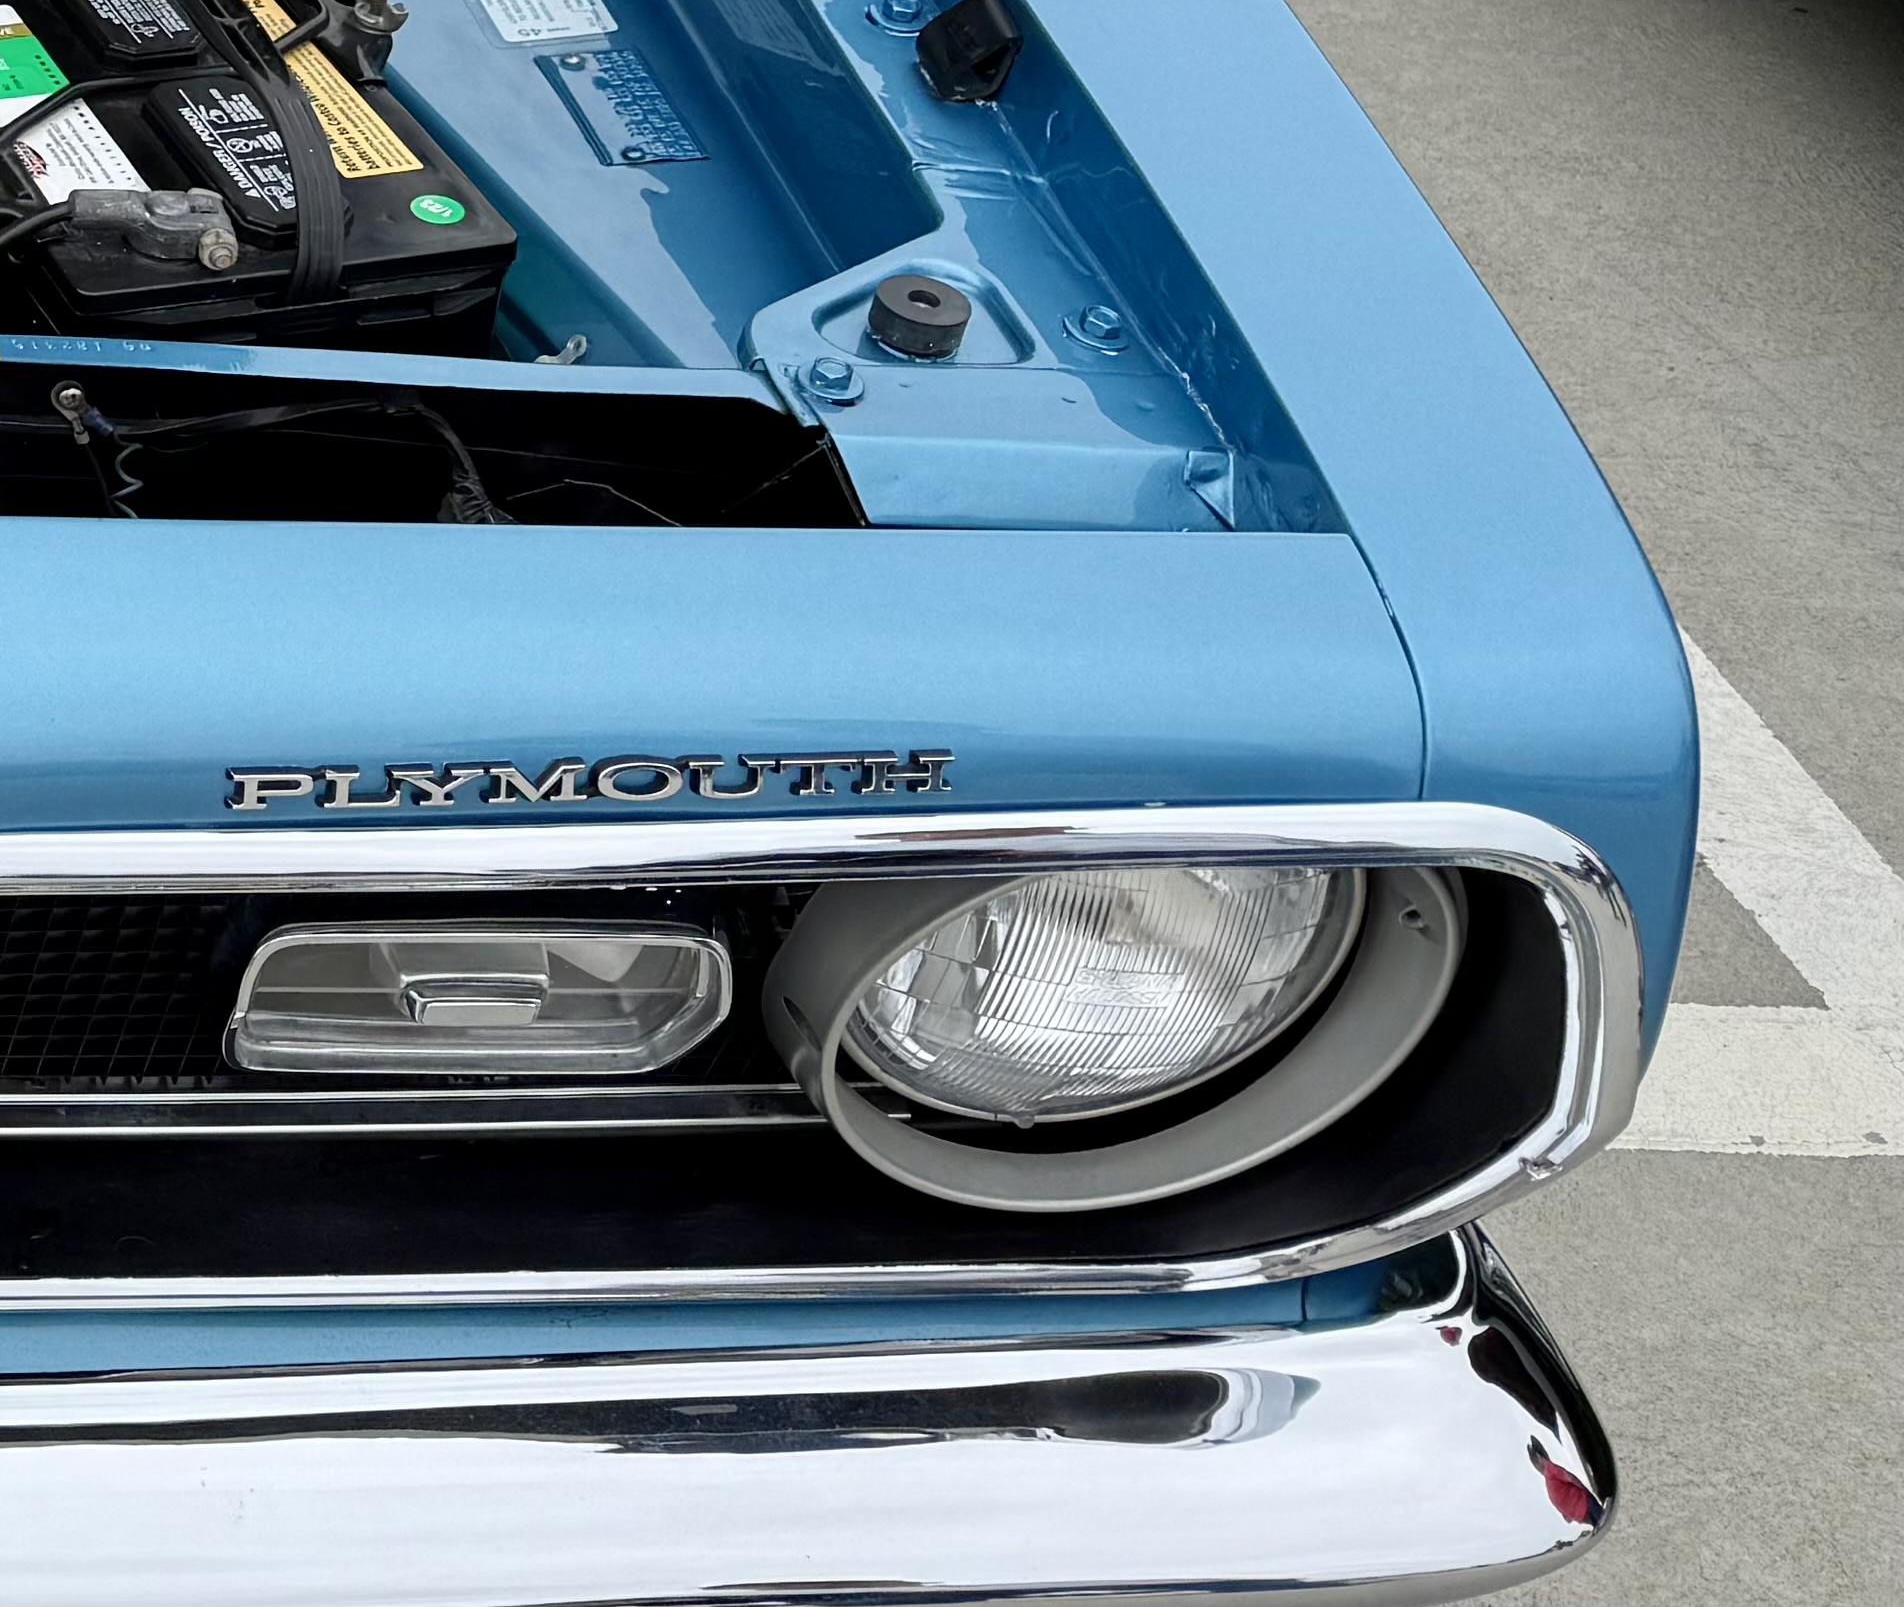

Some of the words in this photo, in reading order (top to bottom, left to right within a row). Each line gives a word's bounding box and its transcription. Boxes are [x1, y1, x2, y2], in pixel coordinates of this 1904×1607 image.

[178, 106, 214, 142] POISON
[315, 102, 342, 126] Costco
[213, 149, 253, 189] DANGER
[225, 749, 957, 812] PLYMOUTH
